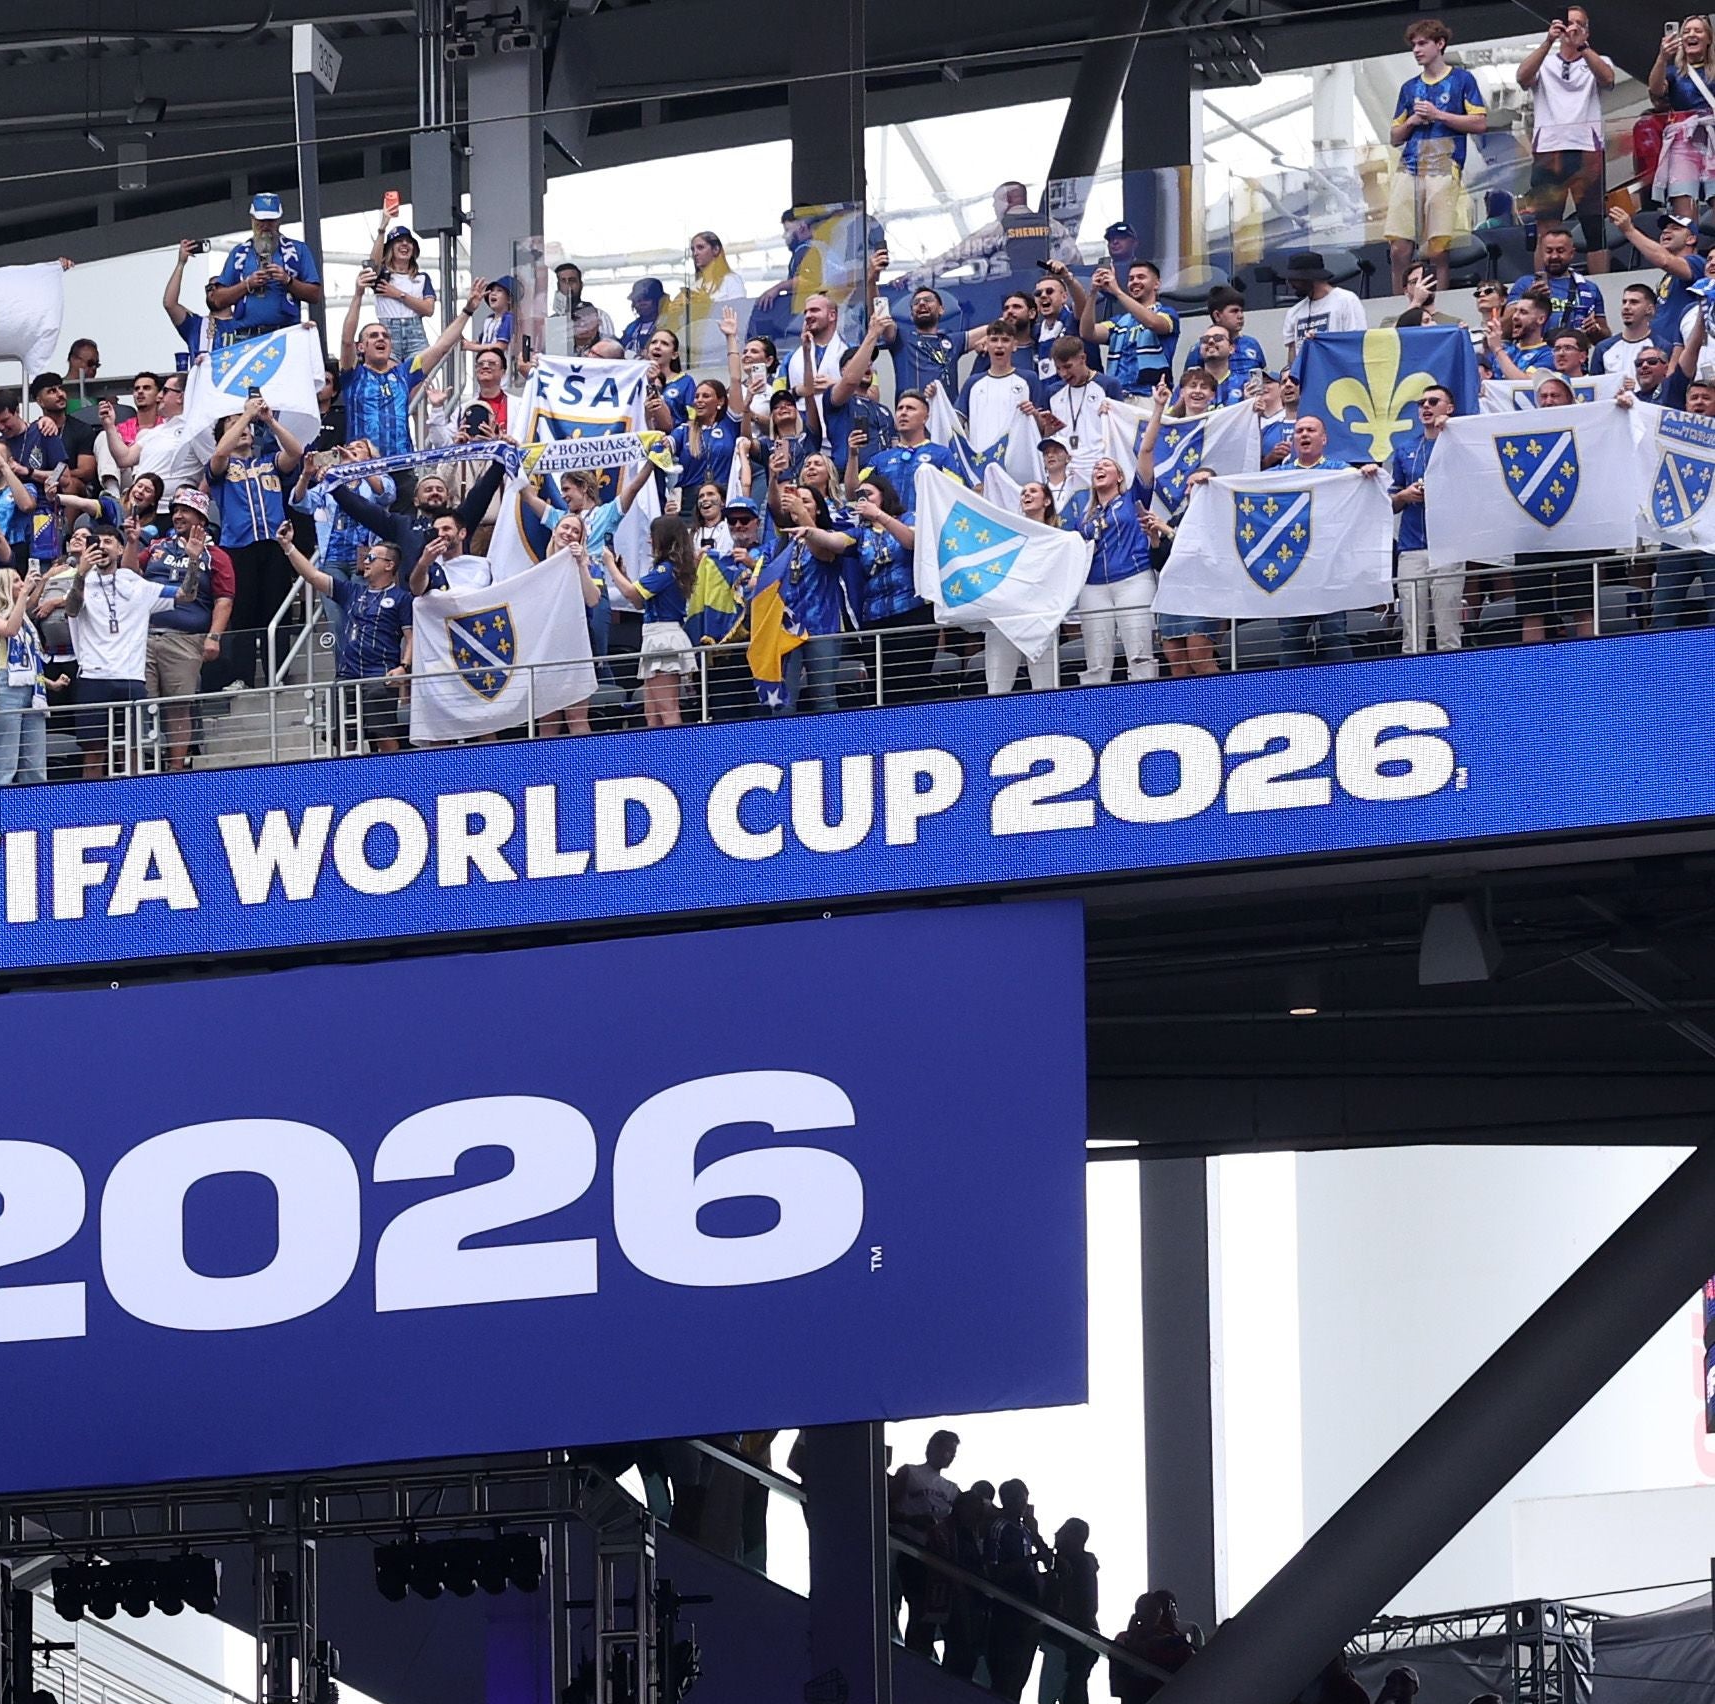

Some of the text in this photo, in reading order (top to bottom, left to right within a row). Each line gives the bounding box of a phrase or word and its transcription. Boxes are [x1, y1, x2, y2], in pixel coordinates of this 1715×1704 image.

[218, 777, 680, 904] WORLD
[708, 749, 962, 859] CUP
[991, 701, 1453, 835] 2026
